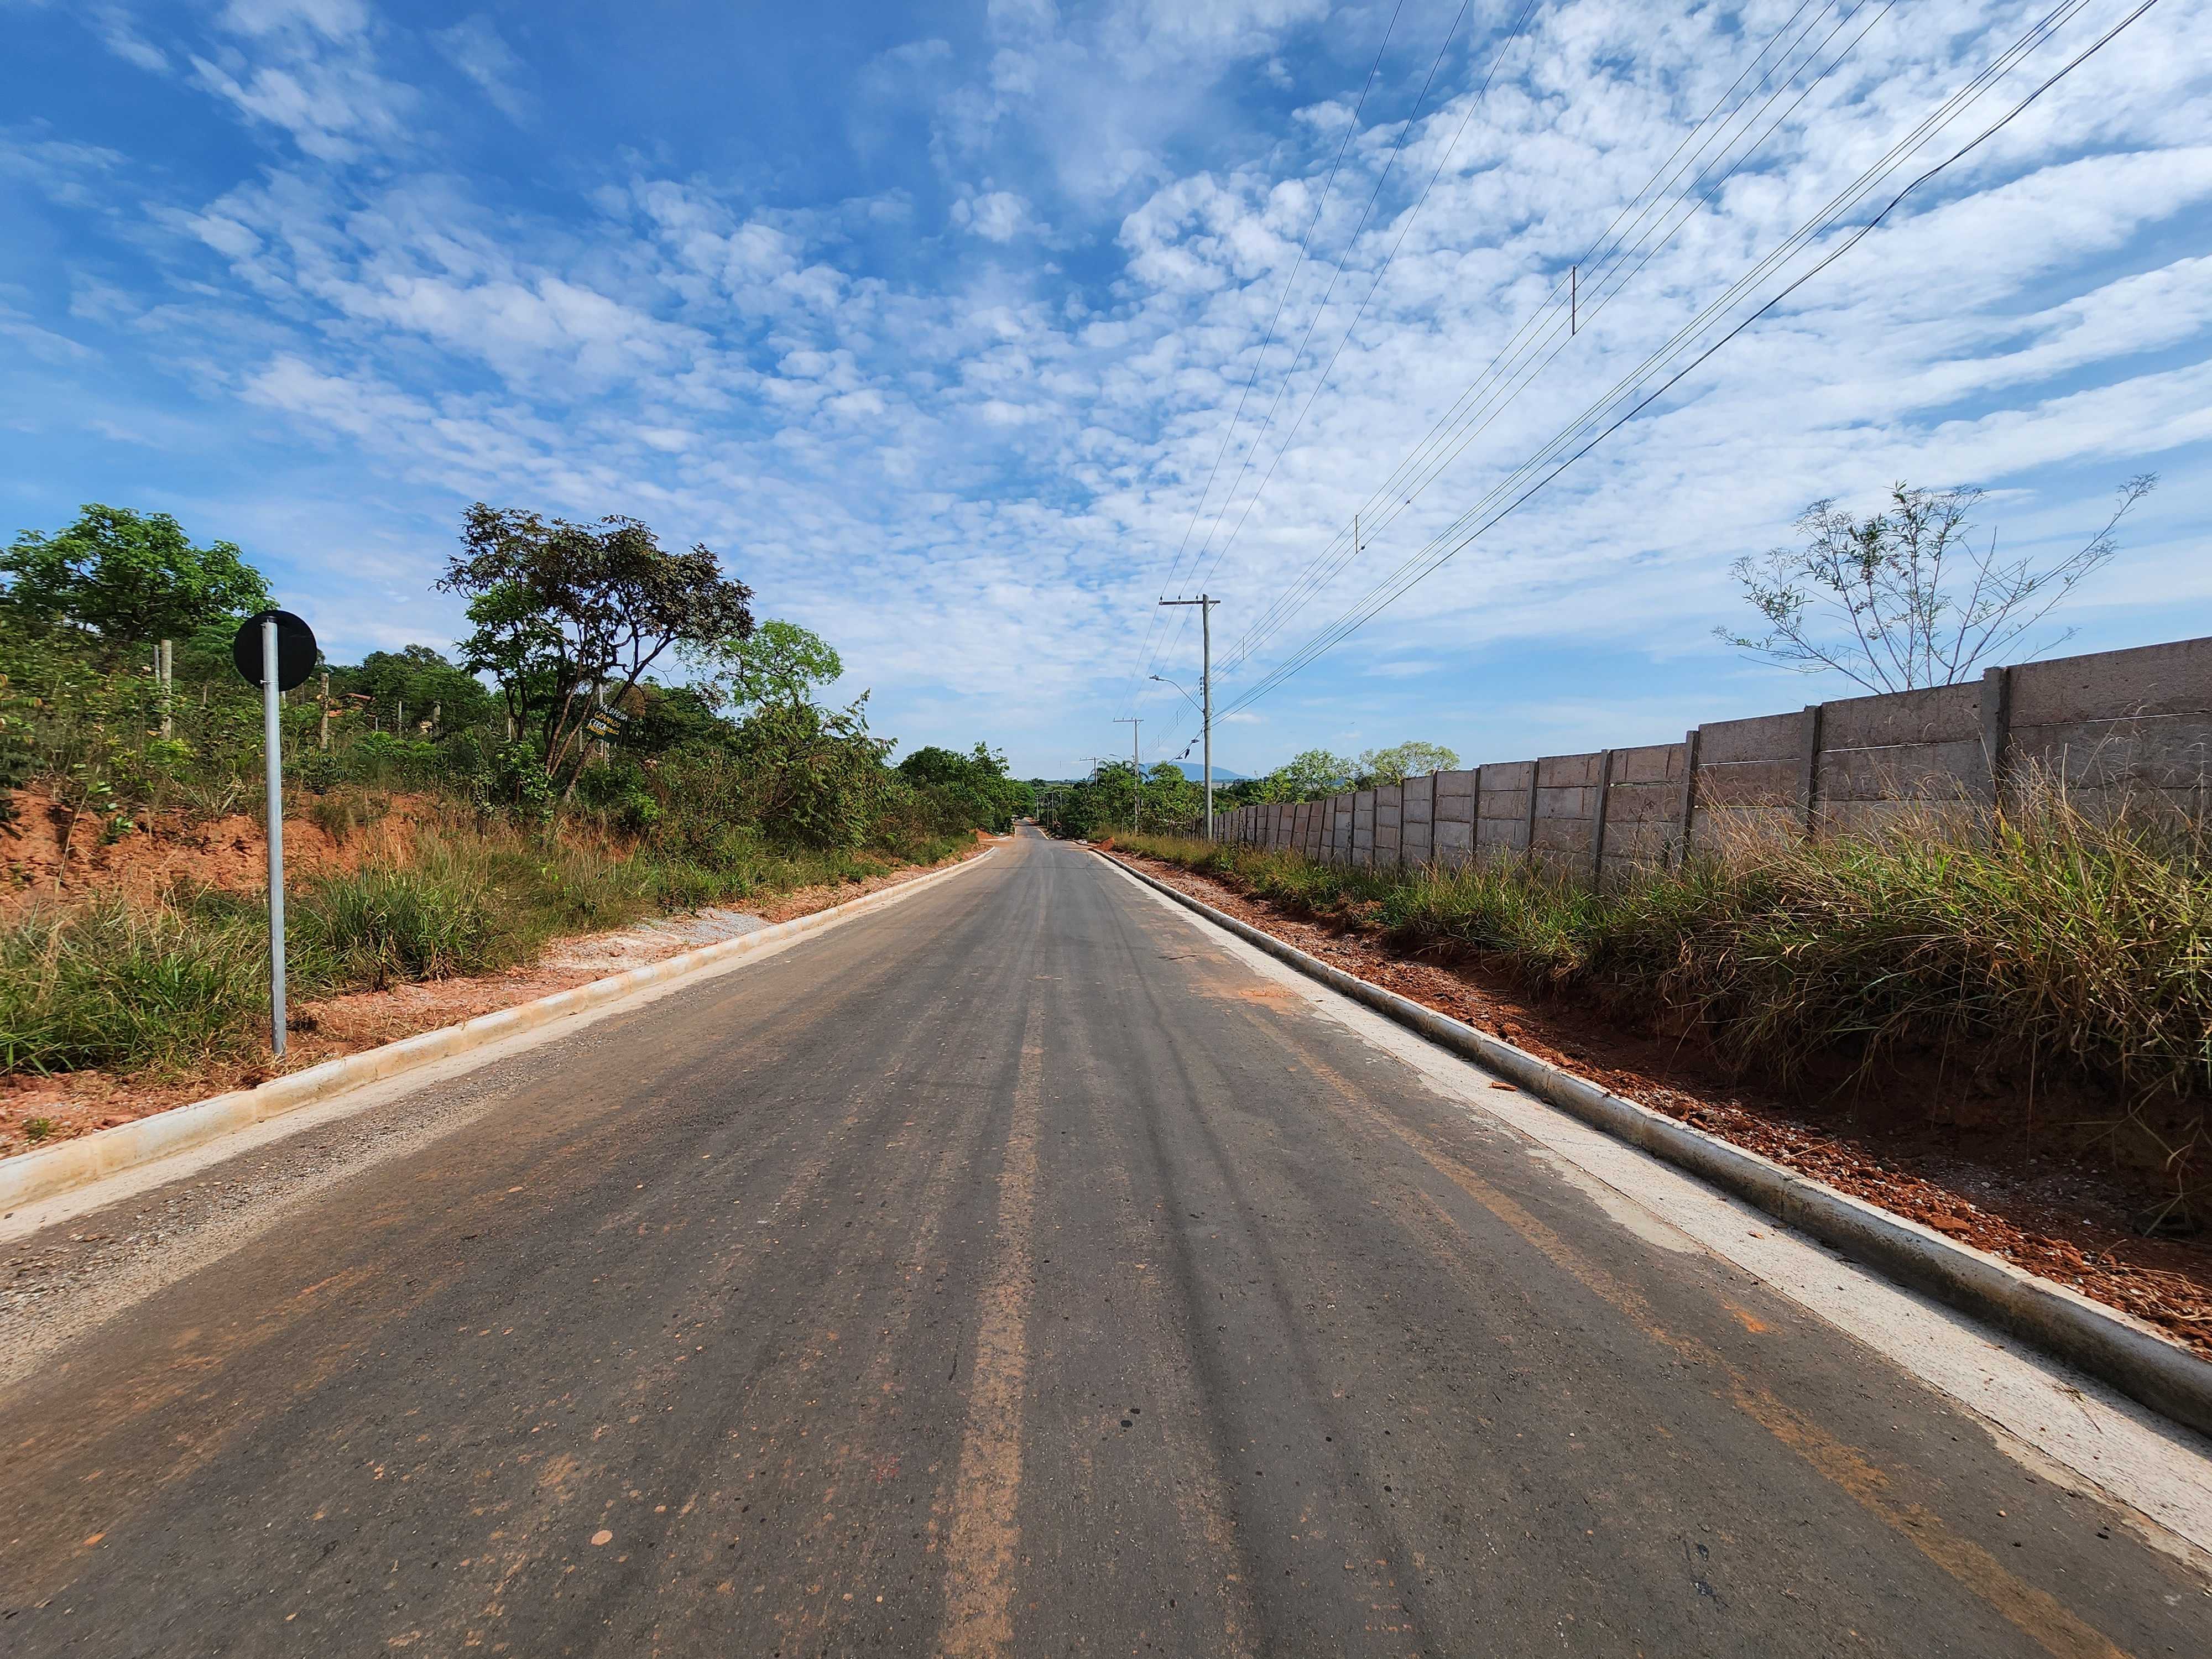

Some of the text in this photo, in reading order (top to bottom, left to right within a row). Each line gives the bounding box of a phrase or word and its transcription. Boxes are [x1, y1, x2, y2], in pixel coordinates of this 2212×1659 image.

[594, 711, 621, 728] GRAMADO
[612, 709, 628, 722] FOSSA
[589, 718, 607, 731] CERCA
